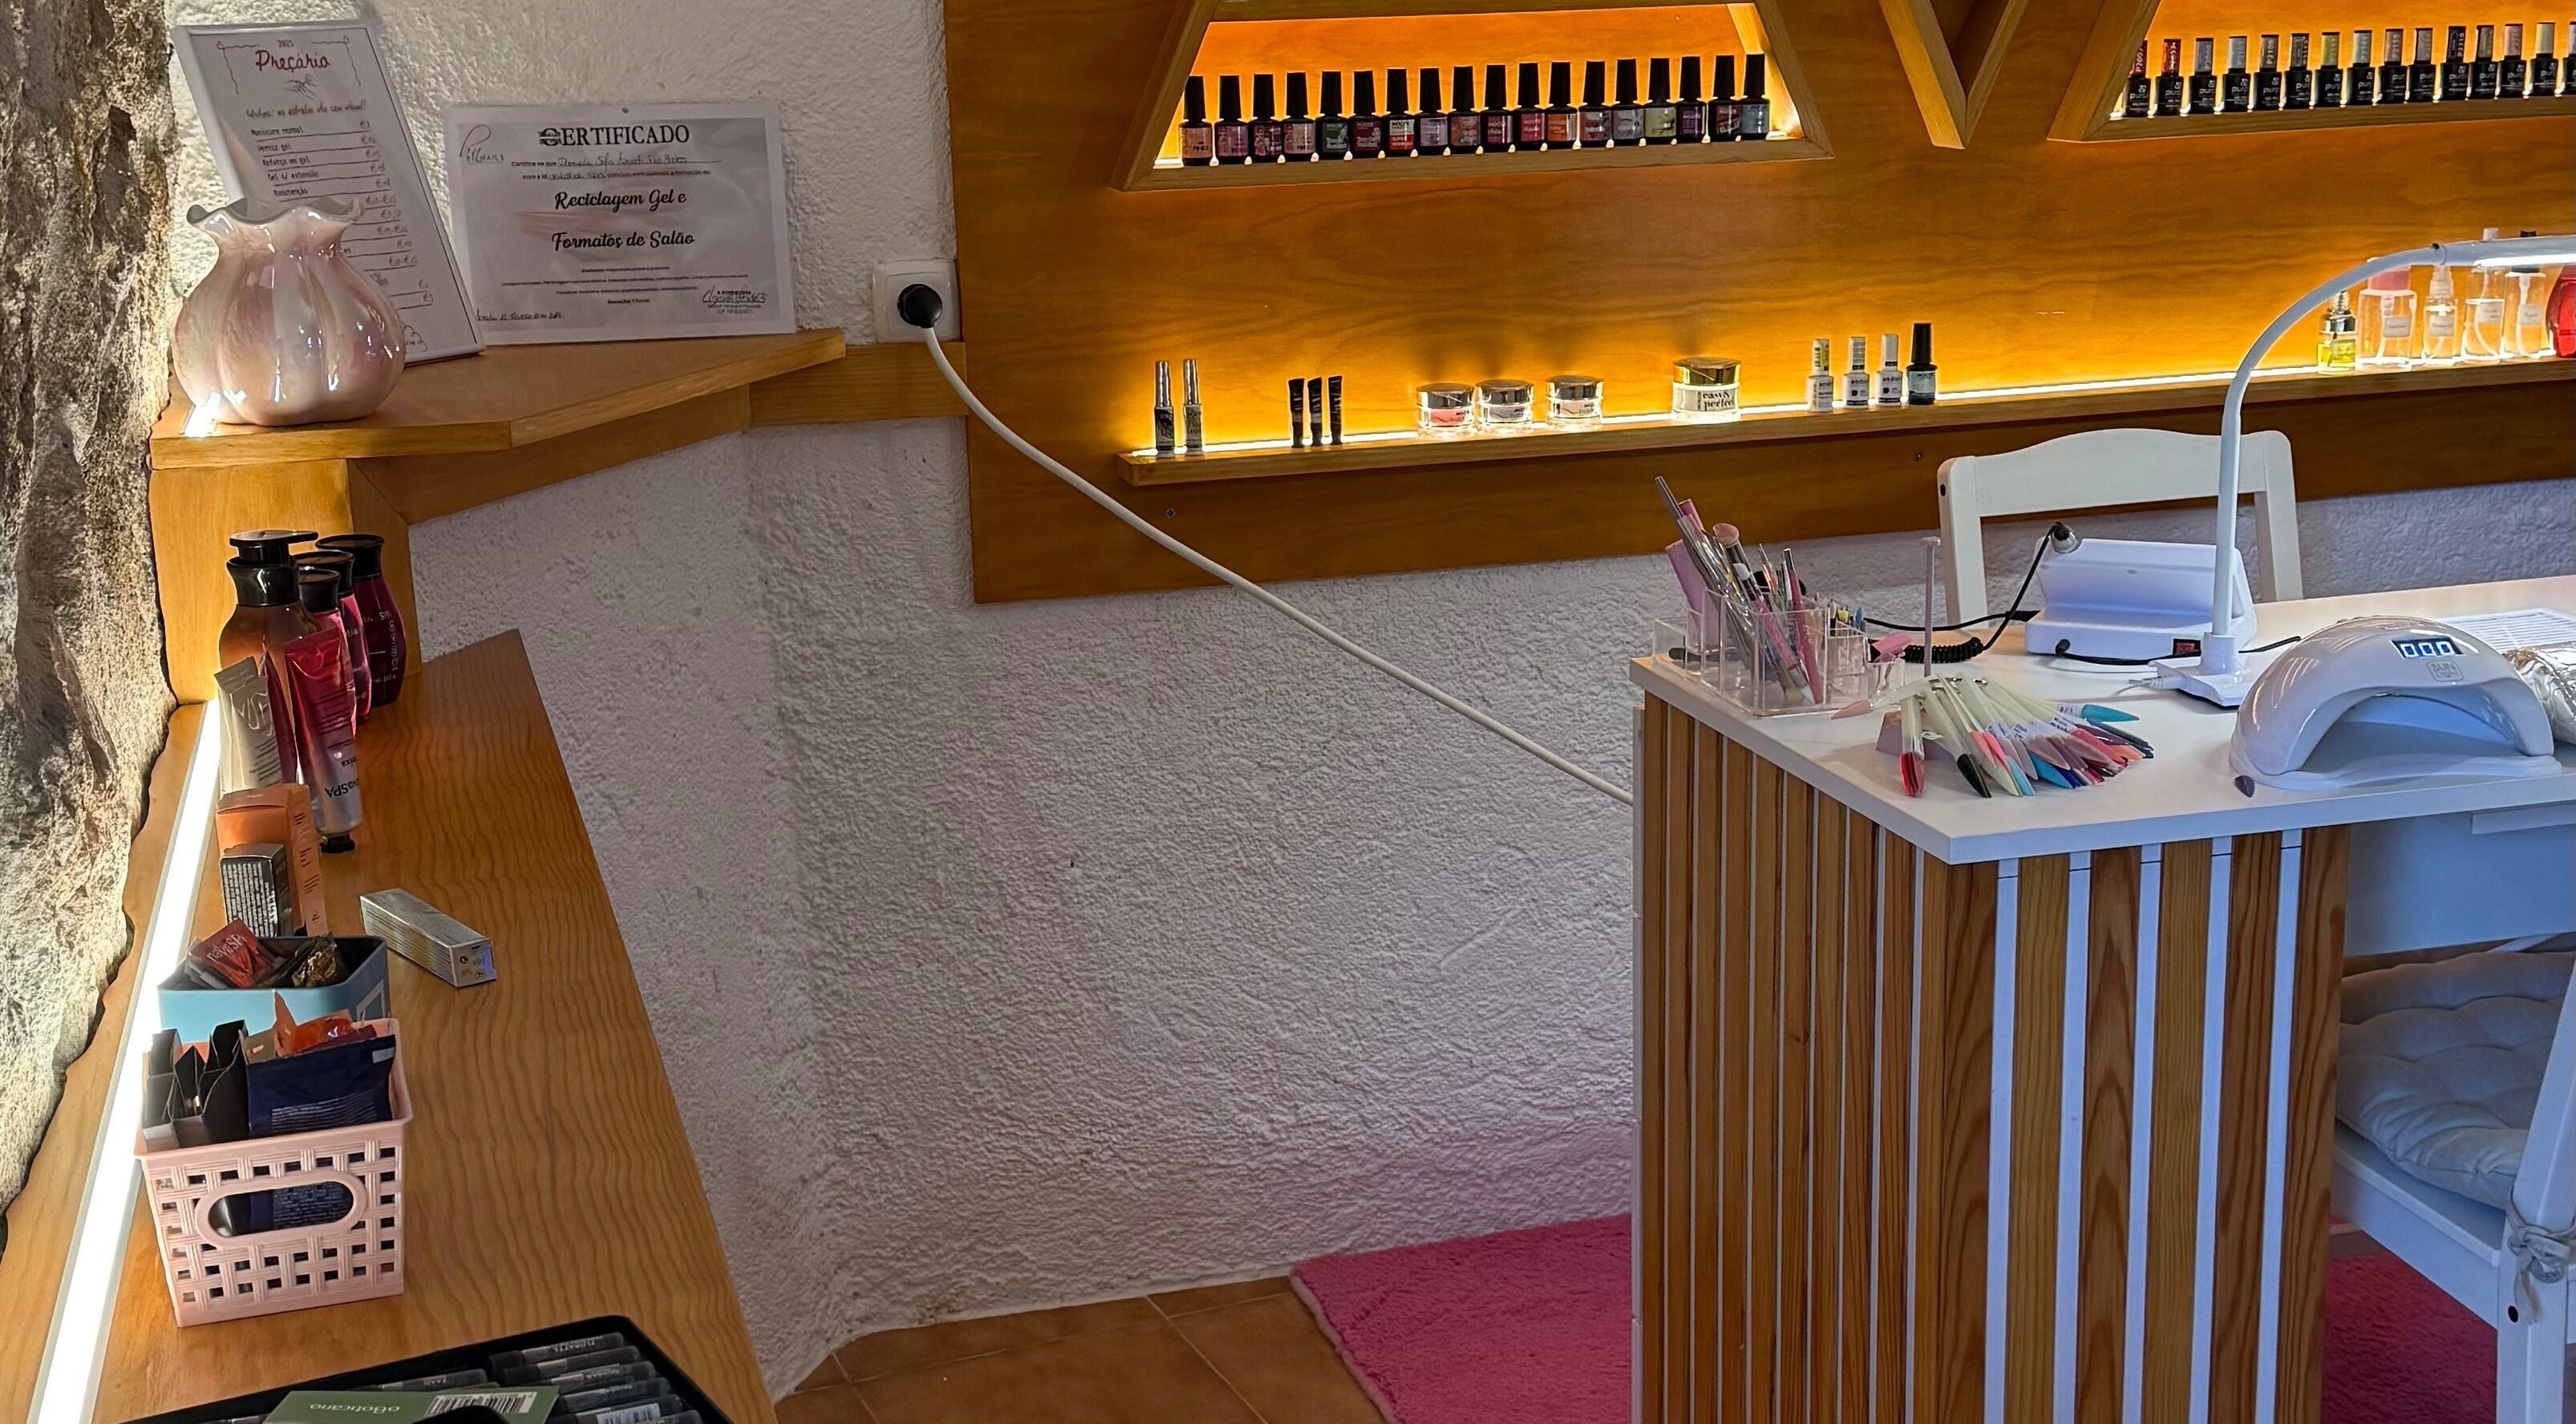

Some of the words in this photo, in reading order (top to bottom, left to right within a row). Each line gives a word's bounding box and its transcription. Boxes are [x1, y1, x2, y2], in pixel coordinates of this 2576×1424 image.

[277, 39, 294, 48] 2025
[254, 50, 331, 73] Preçário
[538, 124, 691, 147] CERTIFICADO
[554, 190, 645, 213] Reciclagem
[649, 188, 674, 212] Gel
[678, 192, 687, 204] e
[551, 231, 623, 251] Formatos
[626, 231, 646, 247] de
[650, 230, 695, 249] Salão
